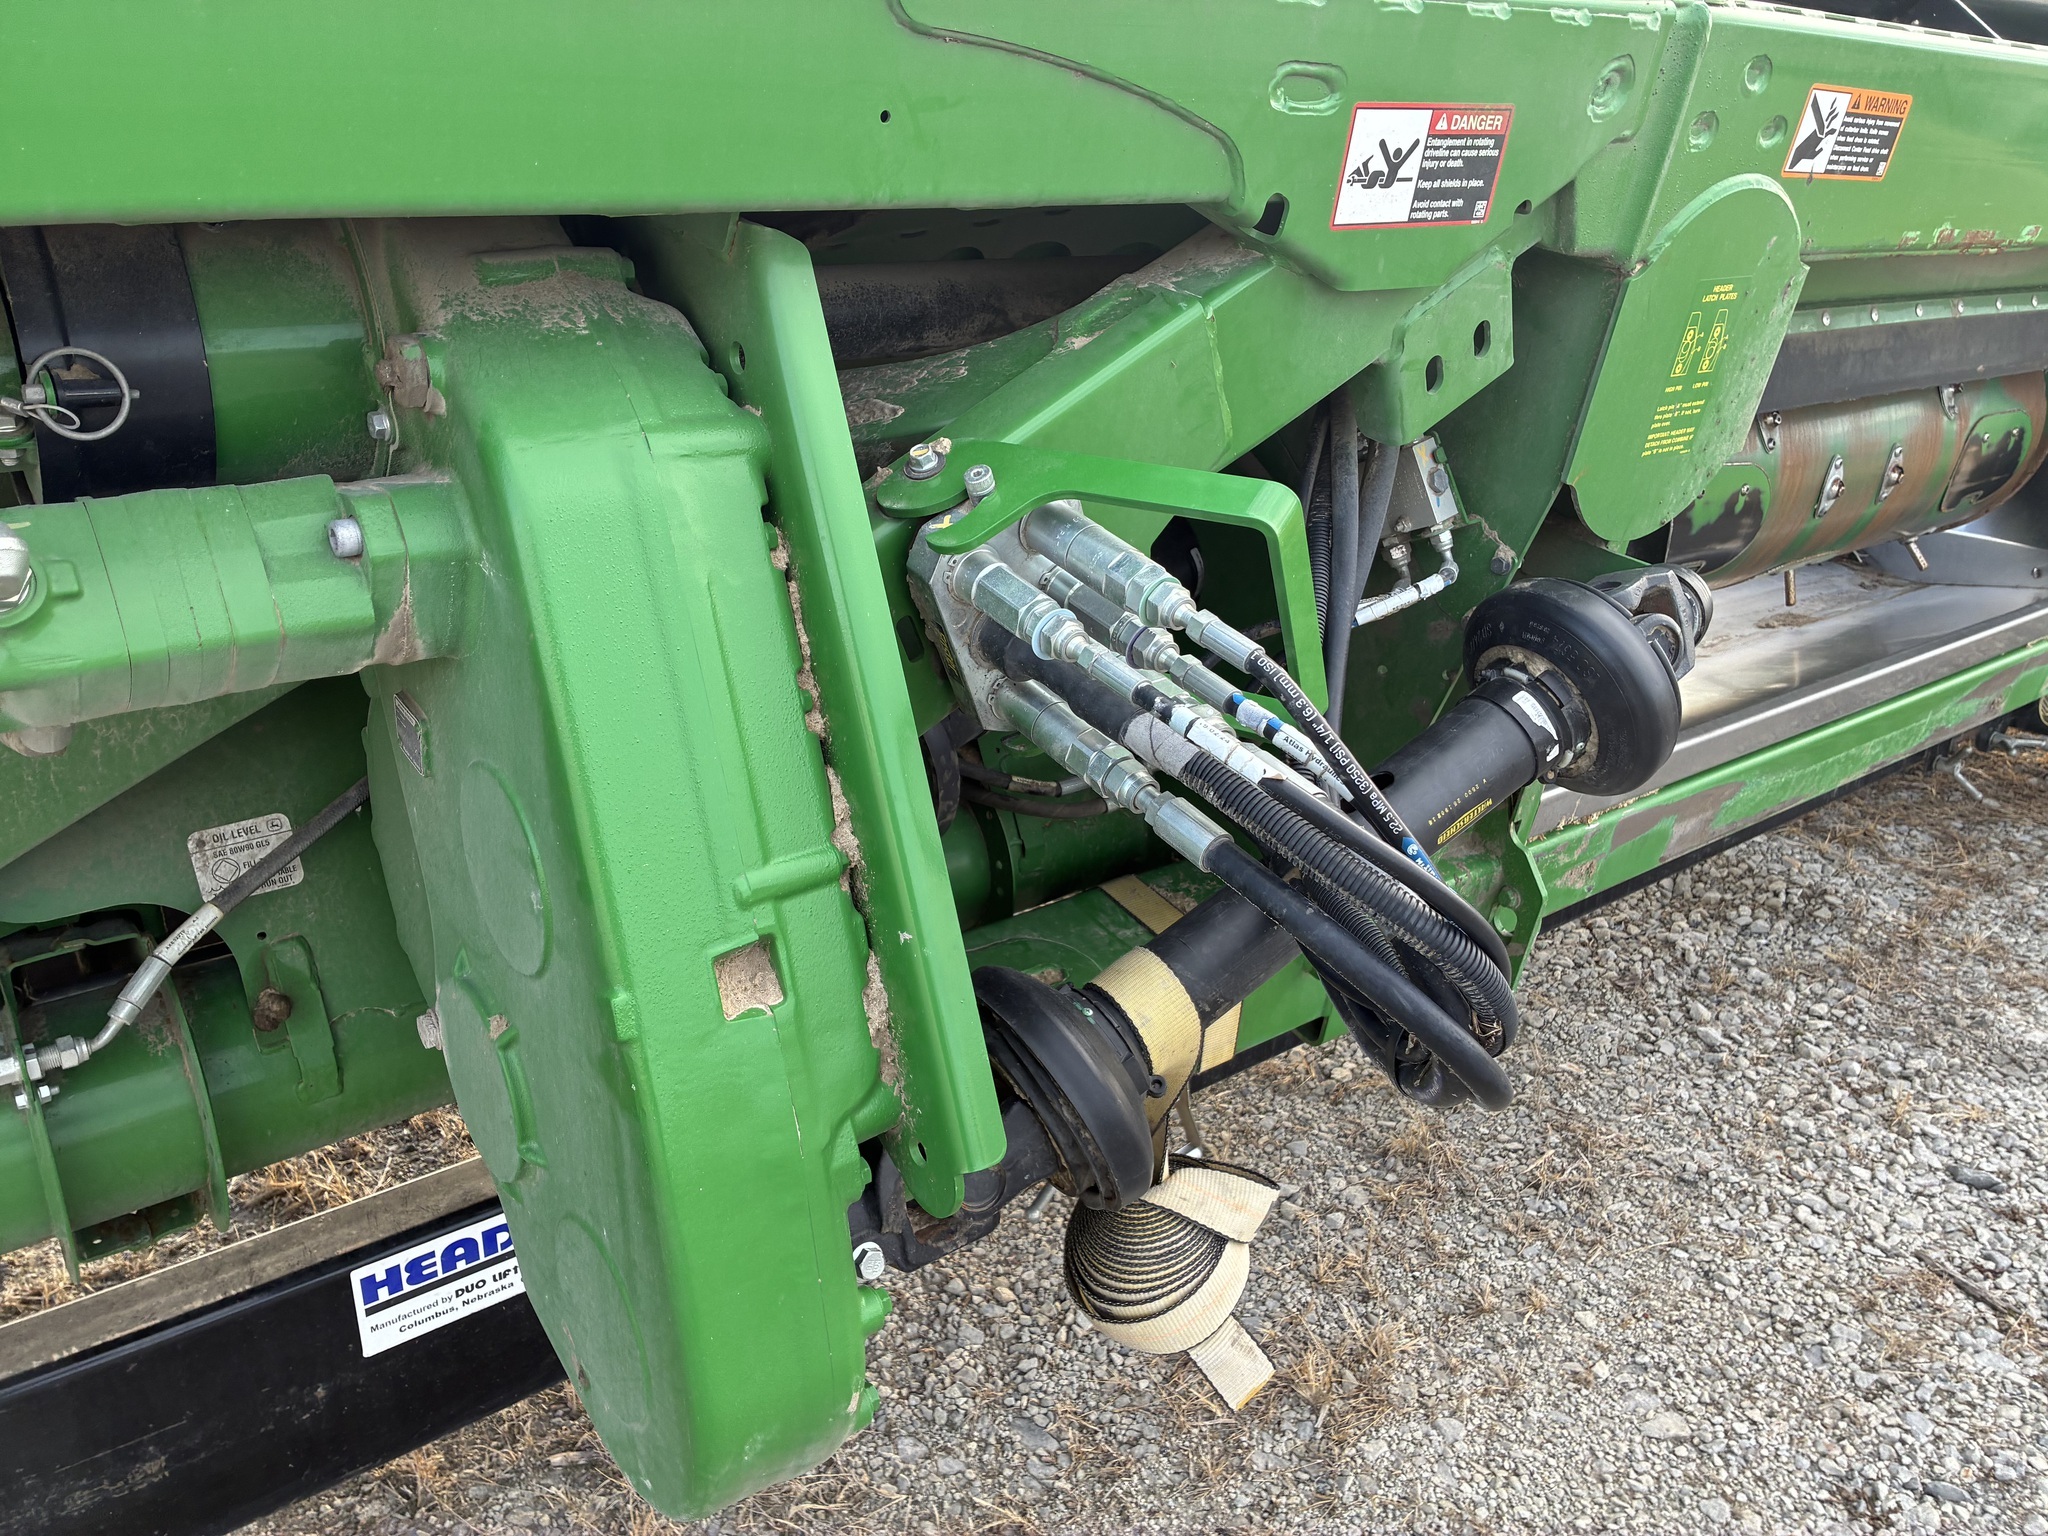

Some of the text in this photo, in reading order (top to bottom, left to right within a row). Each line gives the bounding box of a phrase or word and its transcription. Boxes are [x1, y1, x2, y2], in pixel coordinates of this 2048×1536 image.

[1864, 95, 1908, 115] WARNING
[1450, 114, 1503, 130] DANGER
[1427, 138, 1495, 148] Entanglement in rotating
[1424, 148, 1448, 157] driveline
[1479, 148, 1499, 156] serious
[1422, 159, 1439, 169] injury
[1447, 159, 1464, 167] death.
[1417, 180, 1432, 190] Keep
[1441, 178, 1461, 187] shields
[1462, 178, 1467, 187] in
[1468, 179, 1485, 189] place.
[1412, 198, 1463, 209] Avoid contact with
[1410, 210, 1449, 220] rotating parts.
[1702, 292, 1738, 302] LATCH PLATES
[1713, 284, 1734, 292] HEADER
[1258, 657, 1276, 674] ISO
[1273, 672, 1300, 699] mm)
[1295, 698, 1317, 722] (6.3
[1312, 722, 1334, 745] 1/4"
[1283, 736, 1304, 753] Atlas
[1328, 742, 1346, 765] PSI)
[1346, 764, 1372, 795] (3250
[1371, 792, 1387, 815] MPa
[1382, 811, 1403, 835] 22.5
[1437, 798, 1493, 844] WALTERSCHEID
[212, 825, 261, 843] OIL LEVEL
[213, 839, 270, 859] SAE 80W90 GL5
[278, 875, 293, 883] OUT
[370, 1300, 439, 1333] Manufactured
[441, 1295, 454, 1305] by
[455, 1279, 487, 1299] DUO
[399, 1281, 514, 1333] Columbus, Nebraska
